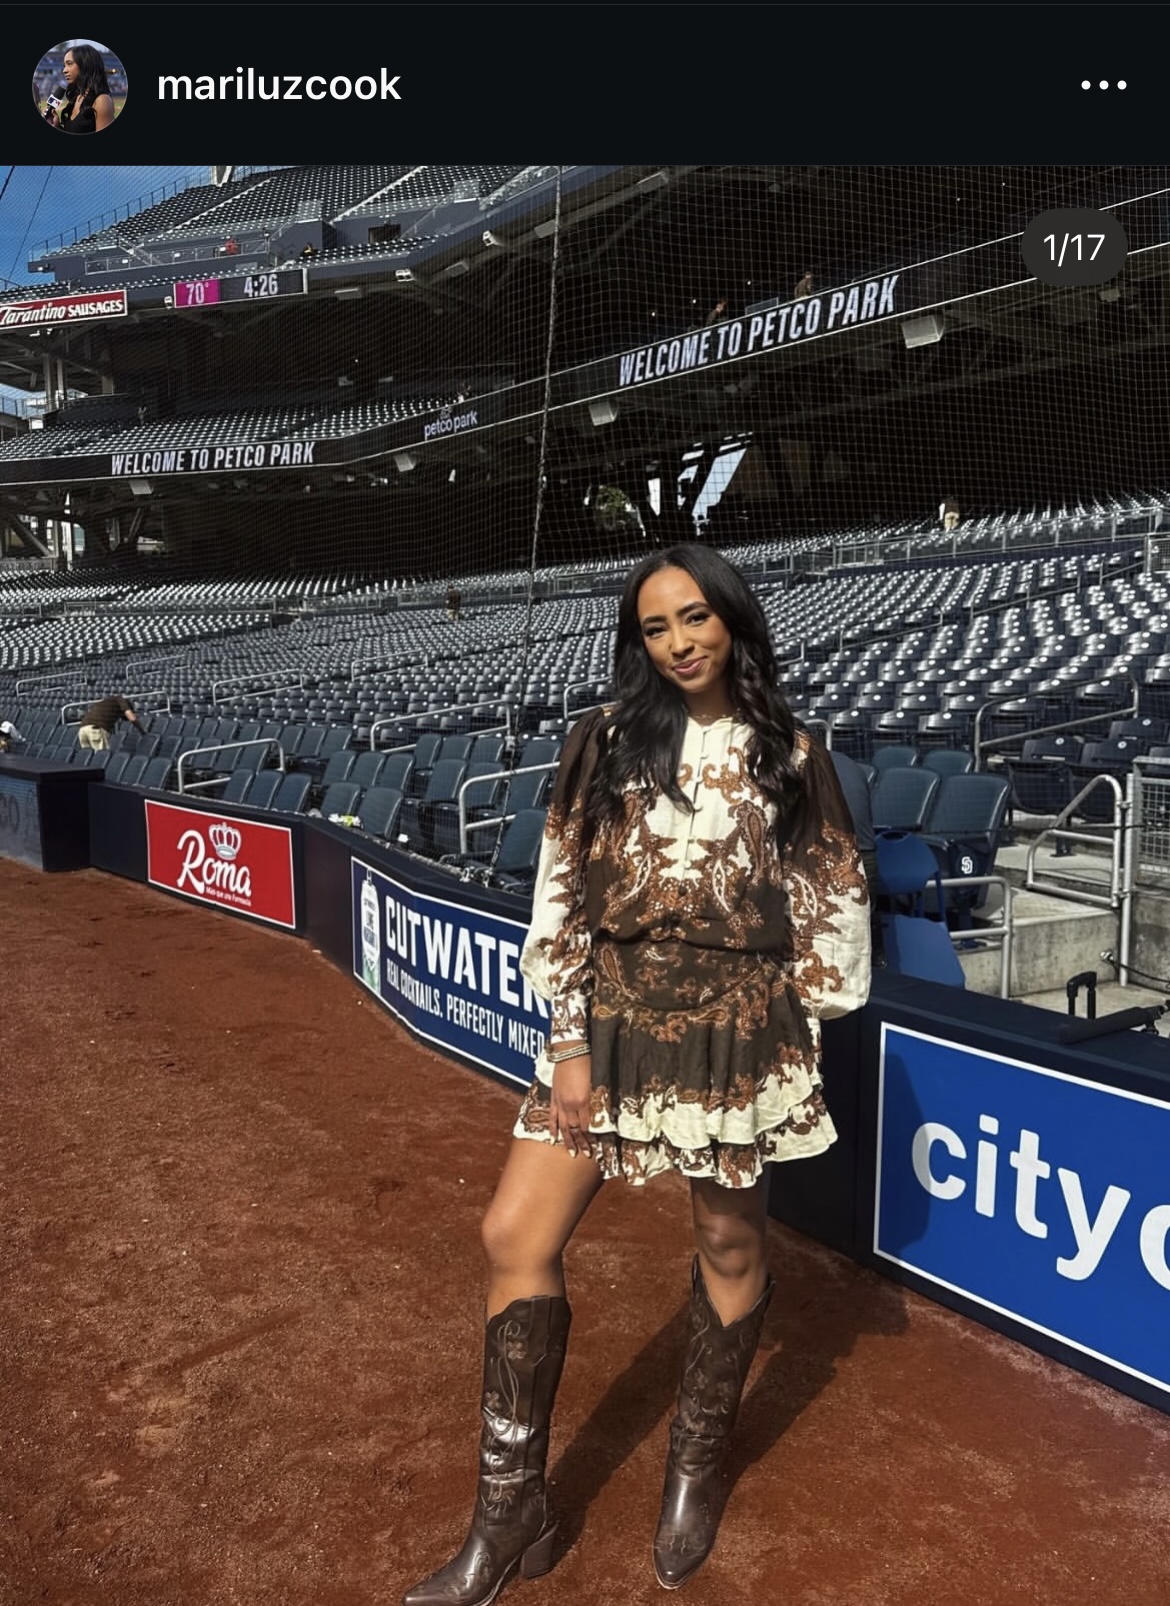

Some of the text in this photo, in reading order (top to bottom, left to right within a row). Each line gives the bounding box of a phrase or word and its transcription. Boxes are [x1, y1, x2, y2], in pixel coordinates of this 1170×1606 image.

[243, 274, 278, 297] 4:26
[0, 299, 123, 325] Tarantino SAUSAGES
[619, 274, 899, 386] WELCOME TO PETCO PARK
[424, 410, 478, 441] petco park
[110, 442, 314, 475] WELCOME TO PETCO PARK
[177, 829, 252, 897] Roma
[386, 958, 400, 991] REAL
[400, 968, 444, 1018] COCKTAILS.
[446, 993, 503, 1044] PERFECTLY
